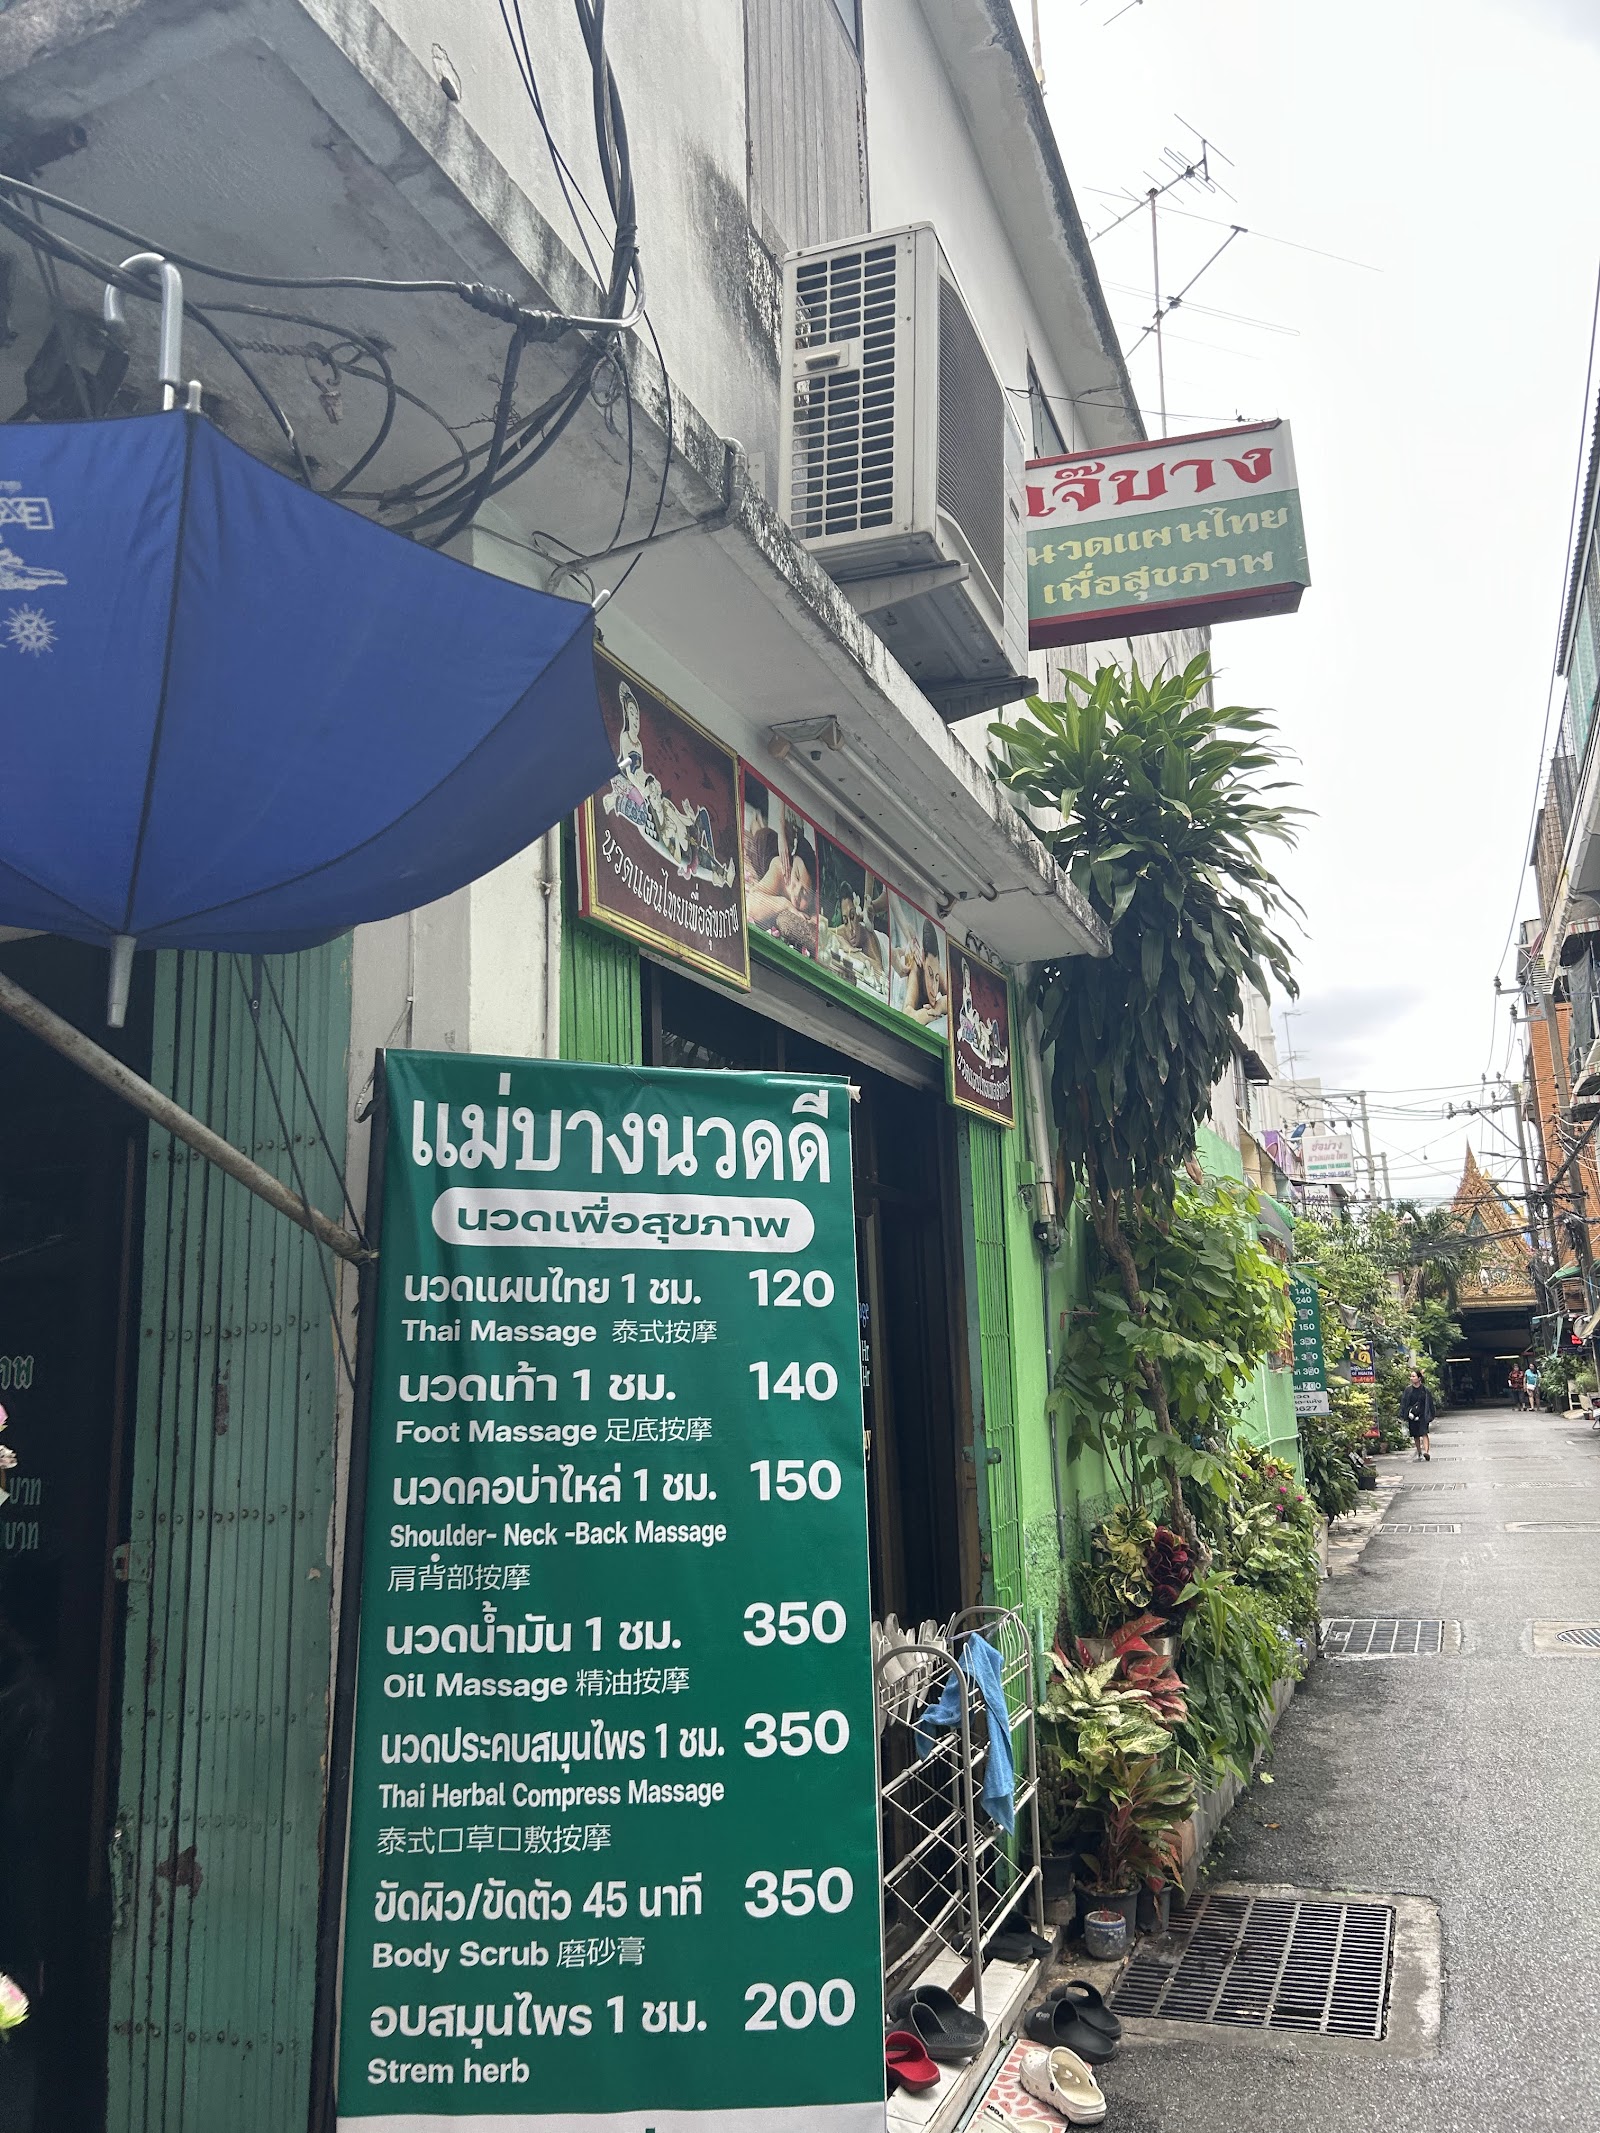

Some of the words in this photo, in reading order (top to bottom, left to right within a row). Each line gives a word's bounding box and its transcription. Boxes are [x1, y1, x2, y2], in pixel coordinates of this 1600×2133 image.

[1027, 507, 1289, 567] นวดแผนไทย
[1043, 551, 1275, 604] เพื่อสุขภาพ
[411, 1071, 832, 1184] แม่บางนวดดี
[457, 1195, 791, 1245] นวดเพื่อสุขภาพ
[404, 1266, 610, 1304] นวดแผนไทย
[621, 1273, 636, 1304] 1
[649, 1278, 702, 1305] ชม.
[748, 1268, 835, 1308] 120
[1294, 1287, 1311, 1295] 140
[1295, 1296, 1312, 1304] 240
[401, 1318, 461, 1342] Thai
[470, 1319, 597, 1347] Massage
[611, 1318, 718, 1344] 泰式按摩
[1298, 1323, 1315, 1331] 150
[399, 1360, 558, 1403] นวดเท้า
[572, 1368, 591, 1401] 1
[608, 1373, 676, 1401] ชม.
[749, 1361, 839, 1401] 140
[395, 1420, 461, 1444] Foot
[468, 1419, 598, 1447] Massage
[604, 1416, 713, 1443] 足底按摩
[393, 1462, 622, 1506] นวดคอบ่าไหล่
[633, 1468, 648, 1502] 1
[662, 1473, 717, 1502] ชม.
[750, 1459, 842, 1501] 150
[635, 1520, 727, 1548] Massage
[387, 1563, 531, 1593] 肩背部按摩
[386, 1600, 572, 1655] นวดน้ำมัน
[585, 1616, 602, 1652] 1
[618, 1620, 682, 1651] ชม.
[743, 1600, 847, 1647] 350
[383, 1672, 426, 1698] Oil
[435, 1672, 568, 1703] Massage
[575, 1666, 690, 1697] 精油按摩
[381, 1718, 646, 1774] นวดประคบสมุนไพร
[655, 1722, 668, 1759] 1
[679, 1726, 725, 1758] ชม.
[743, 1709, 850, 1758] 350
[378, 1782, 426, 1809] Thai
[432, 1781, 507, 1808] Herbal
[512, 1782, 622, 1812] Compress
[628, 1779, 725, 1808] Massage
[374, 1877, 572, 1923] ขัดผิว/ขัดตัว
[582, 1880, 628, 1919] 45
[639, 1871, 703, 1918] นาที
[744, 1866, 854, 1919] 350
[372, 1941, 451, 1974] Body
[459, 1940, 550, 1967] Scrub
[556, 1935, 646, 1969] 磨砂膏
[370, 1991, 593, 2050] อบสมุนไพร
[606, 1995, 624, 2034] 1
[641, 2000, 708, 2033] ชม.
[744, 1978, 856, 2031] 200
[367, 2057, 454, 2085] Strem
[463, 2056, 530, 2084] herb
